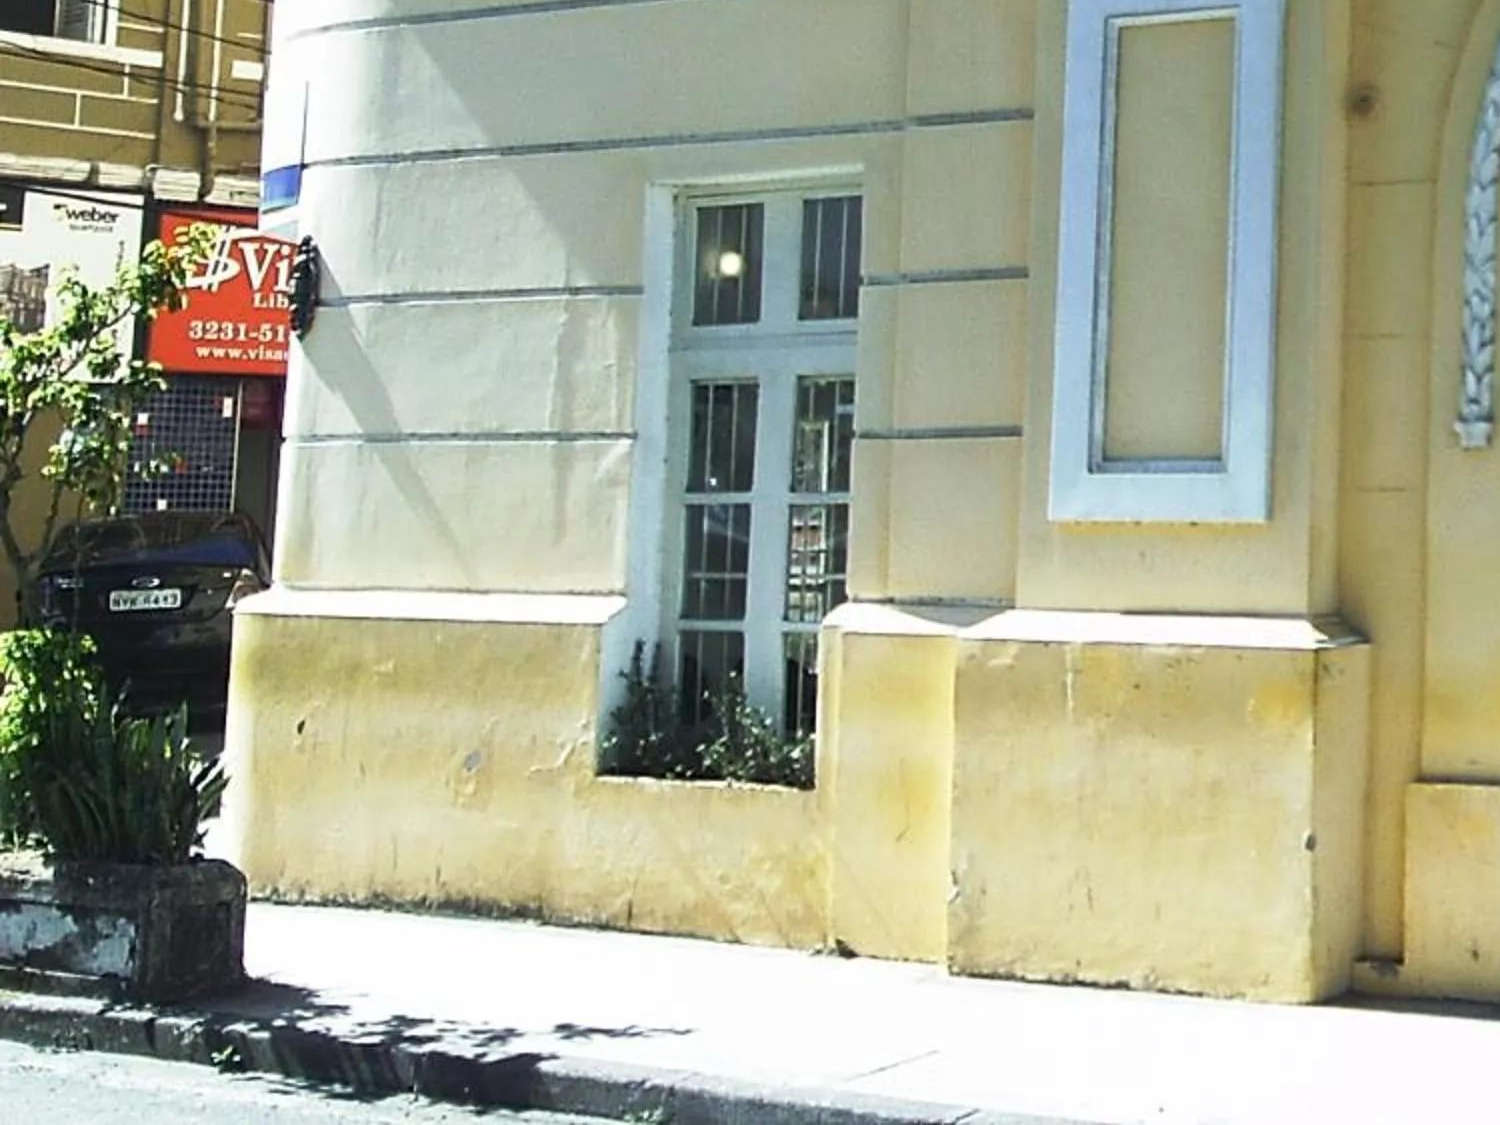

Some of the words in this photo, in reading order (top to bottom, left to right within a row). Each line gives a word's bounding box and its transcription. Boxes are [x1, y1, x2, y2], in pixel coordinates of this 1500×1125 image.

[65, 206, 119, 224] weber
[238, 242, 295, 292] Vi
[195, 345, 287, 361] www.visa
